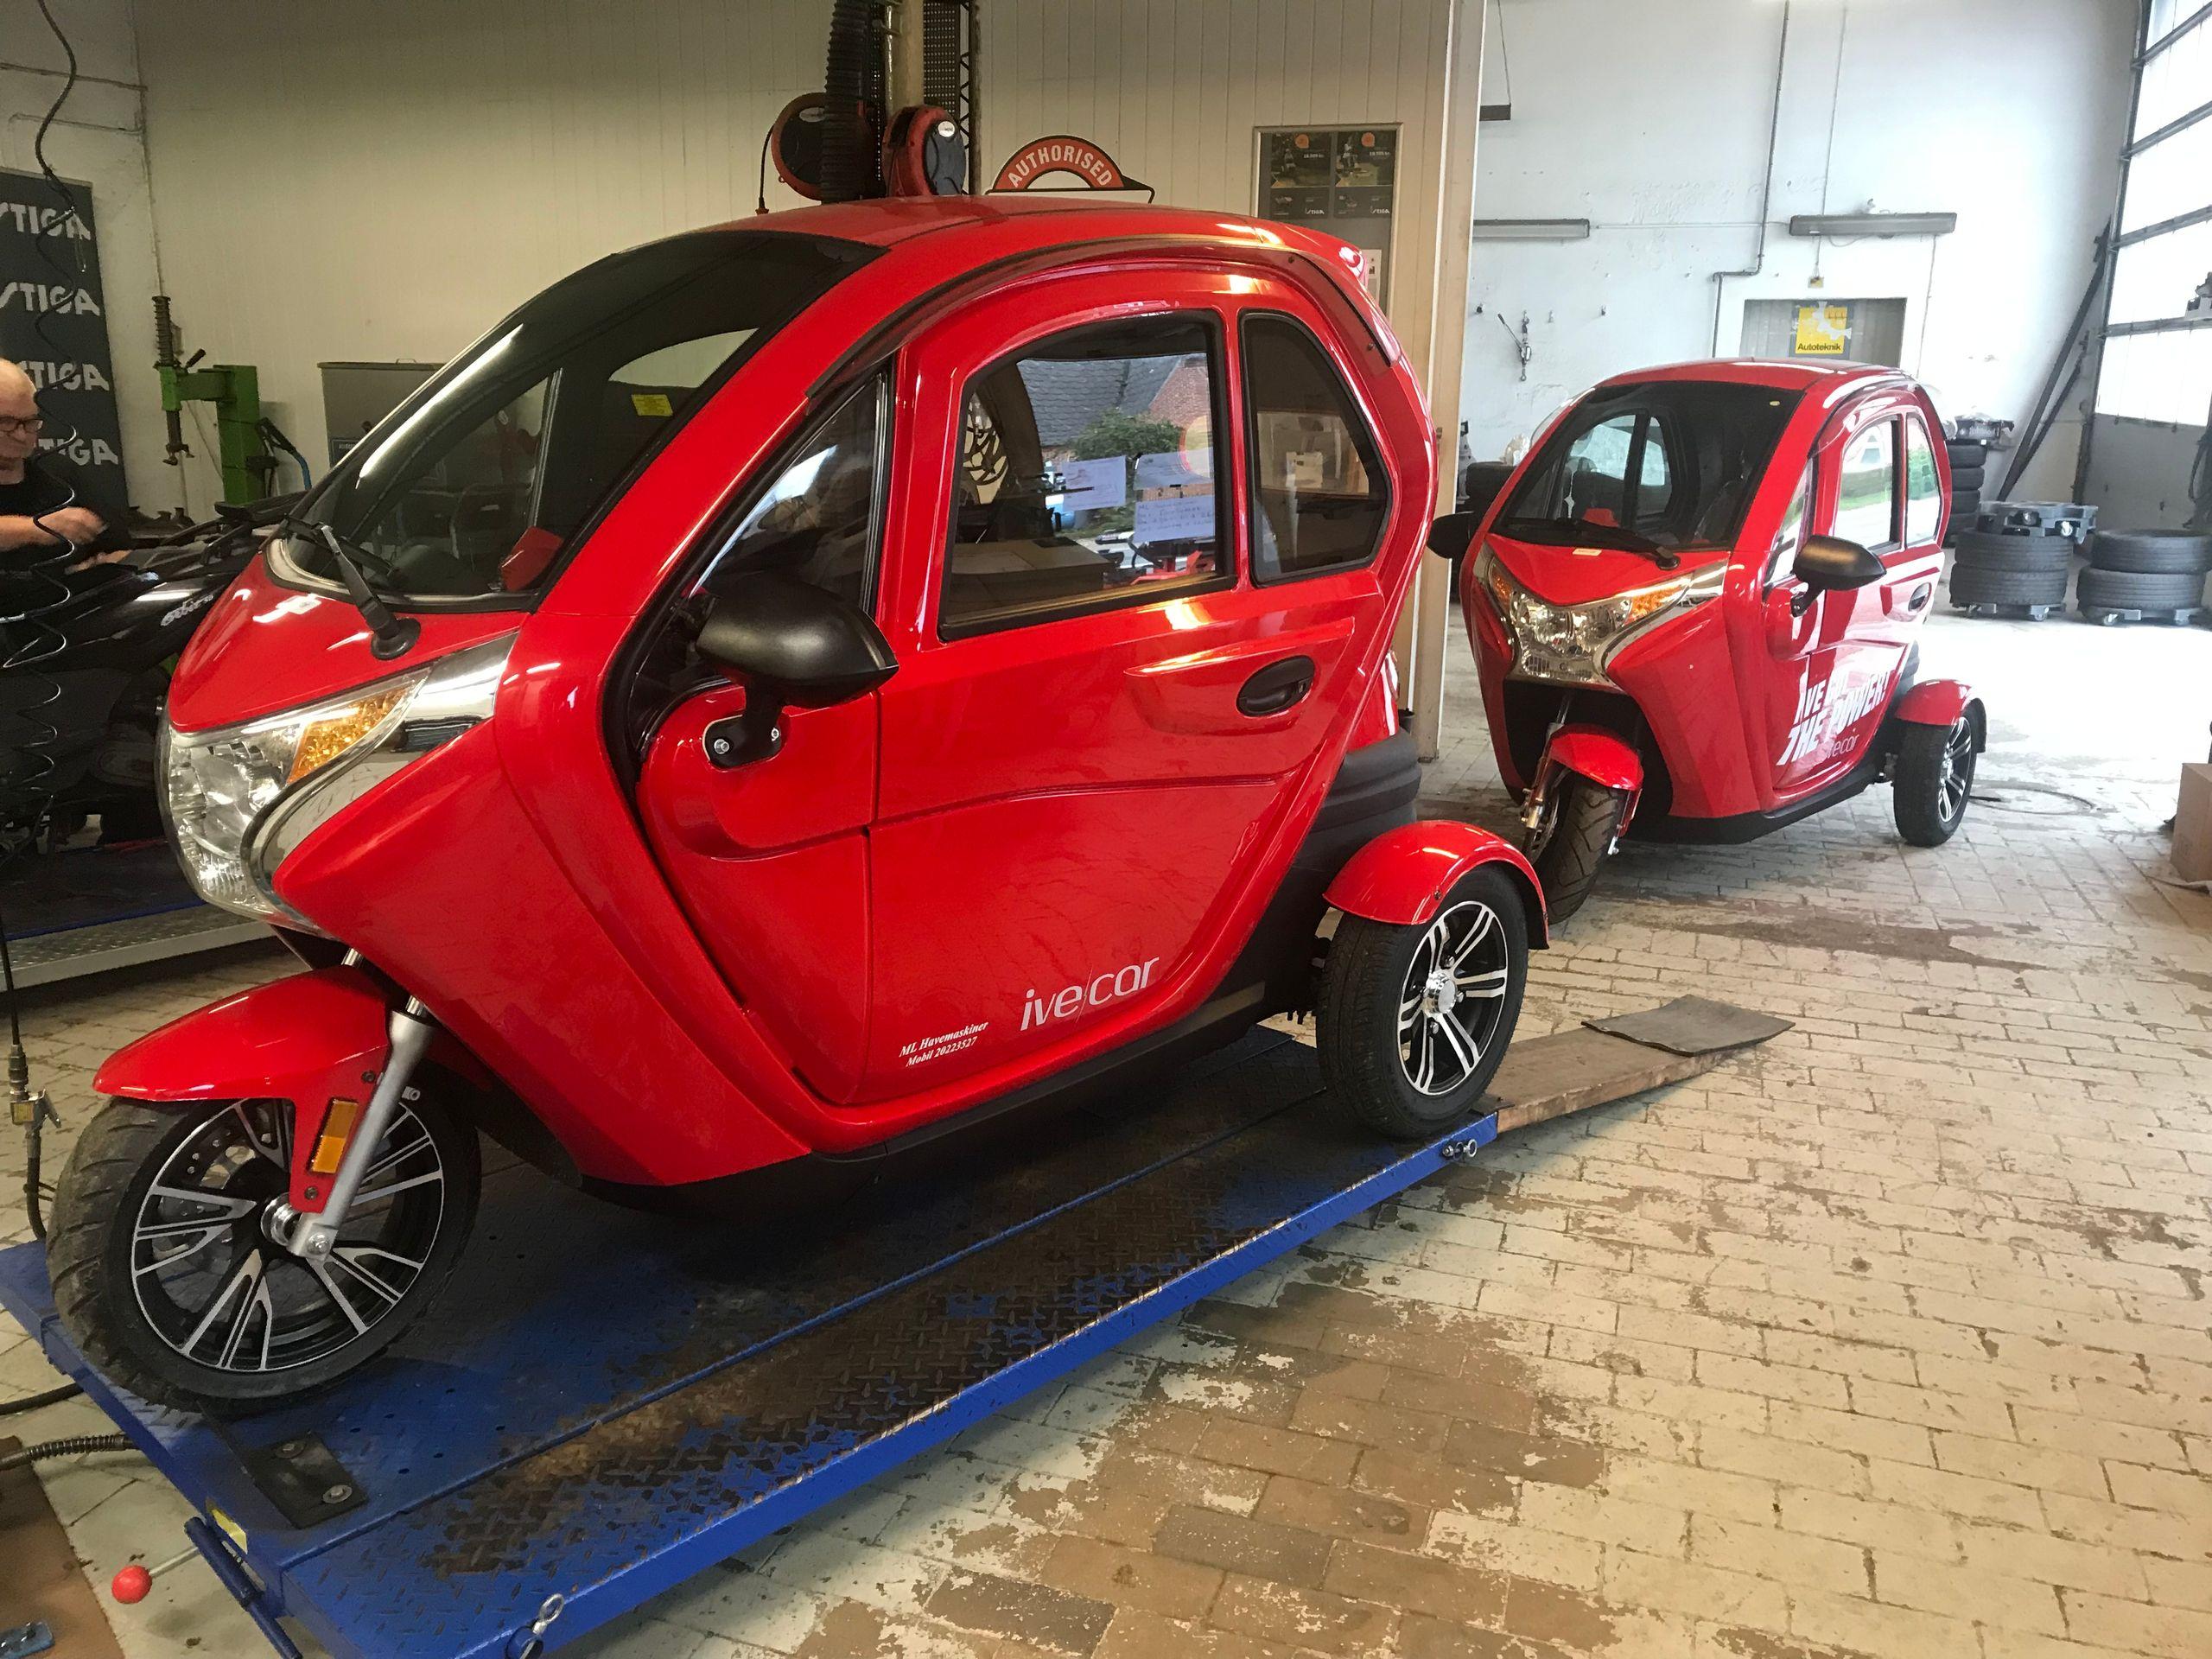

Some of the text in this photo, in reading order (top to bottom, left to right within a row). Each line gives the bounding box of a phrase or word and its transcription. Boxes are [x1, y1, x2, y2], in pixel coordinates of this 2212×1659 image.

[1007, 144, 1113, 188] AUTHORISED
[19, 360, 110, 391] TIGA
[1777, 708, 1830, 765] THE
[899, 1021, 988, 1058] ML Havemaskiner
[906, 1036, 978, 1067] Mobil 20223527
